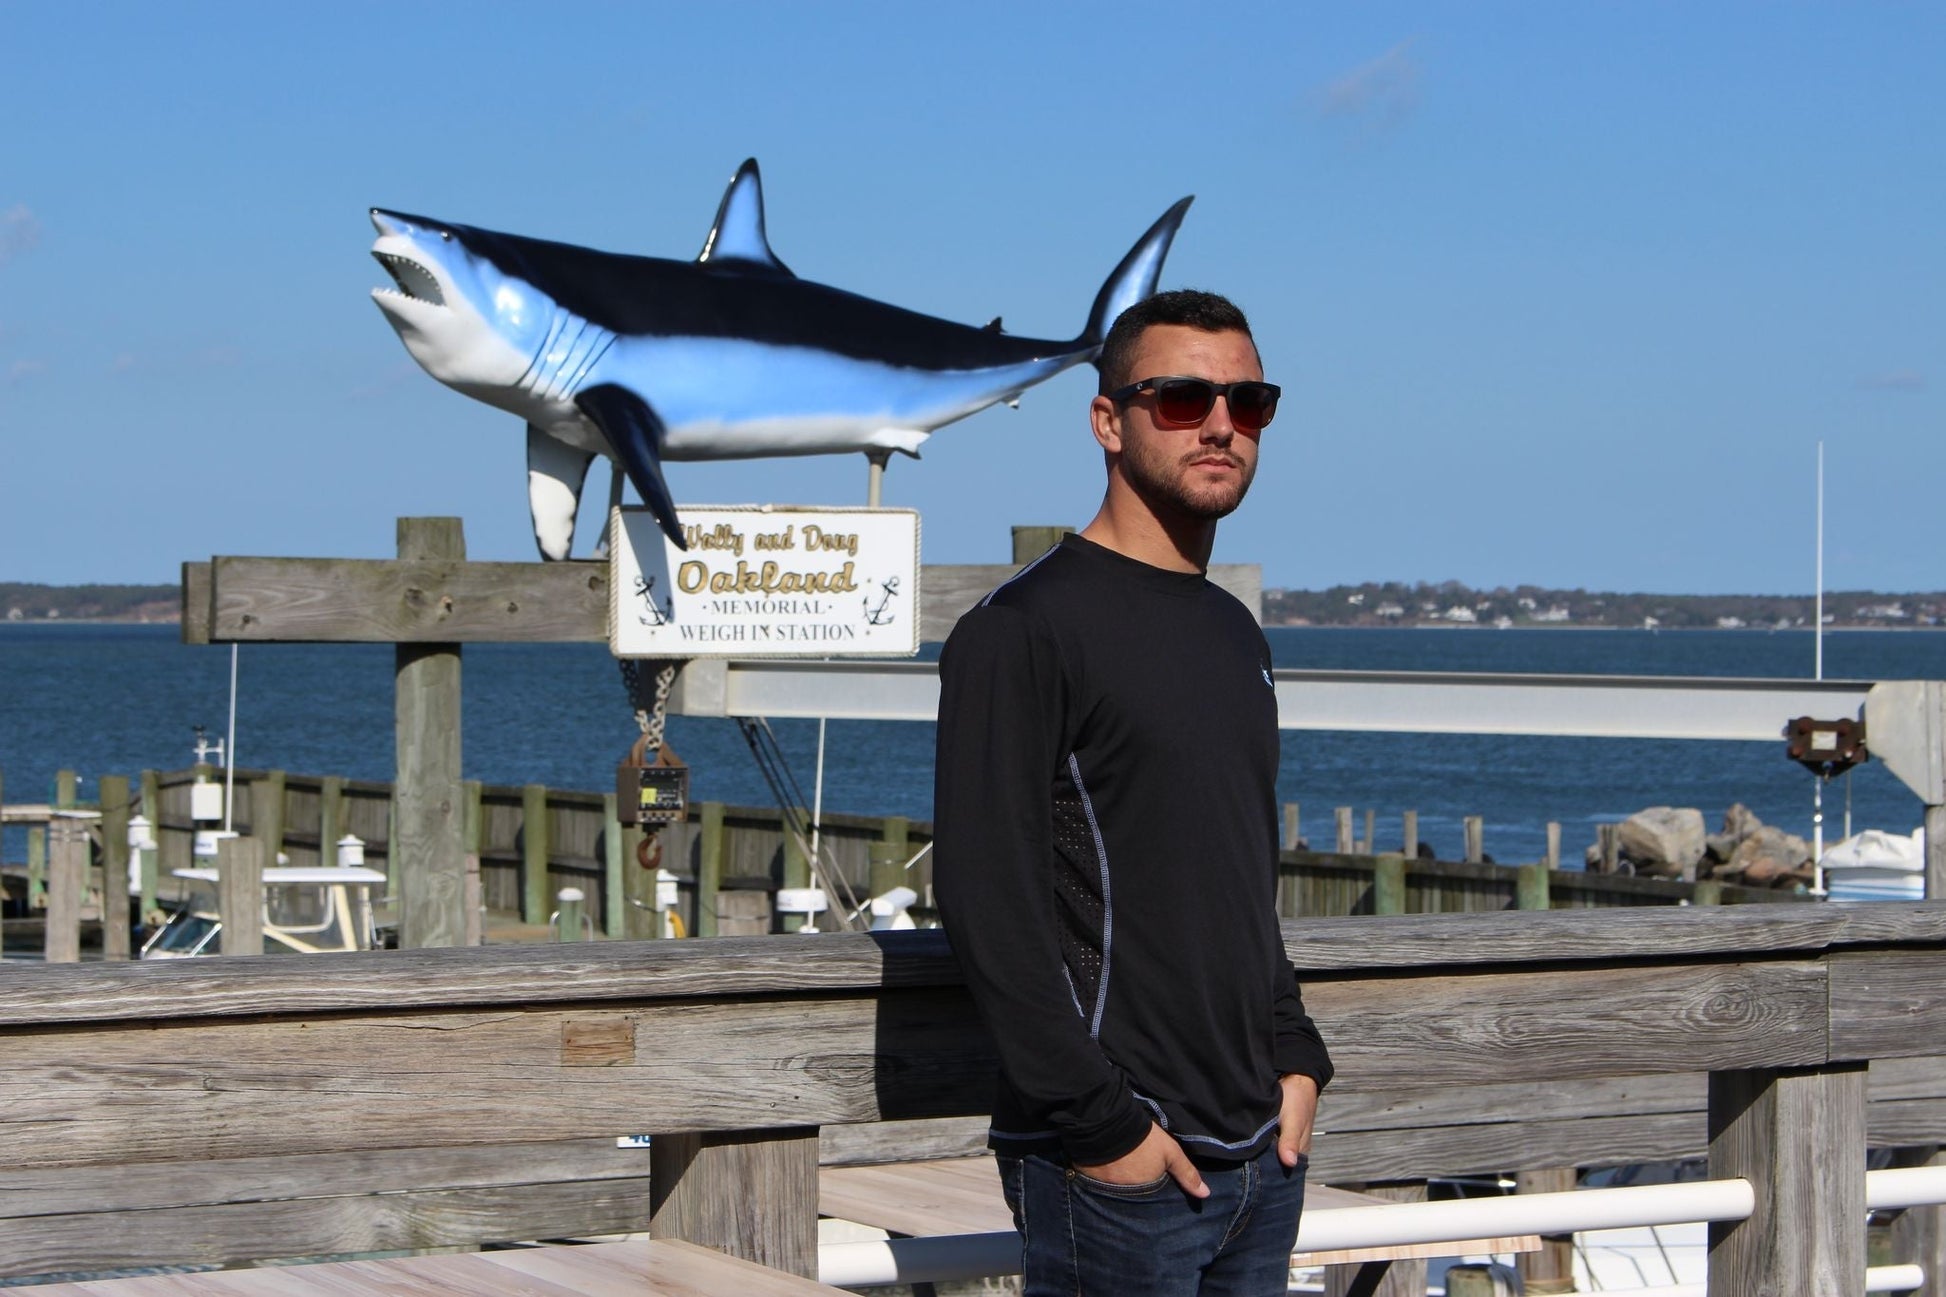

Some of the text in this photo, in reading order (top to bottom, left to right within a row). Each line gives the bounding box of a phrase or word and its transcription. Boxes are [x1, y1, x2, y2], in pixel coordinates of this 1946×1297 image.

[754, 524, 796, 551] and
[801, 524, 858, 557] Doug
[677, 560, 858, 594] Oakland
[711, 600, 826, 615] MEMORIAL
[680, 624, 856, 642] WEIGH IN STATION
